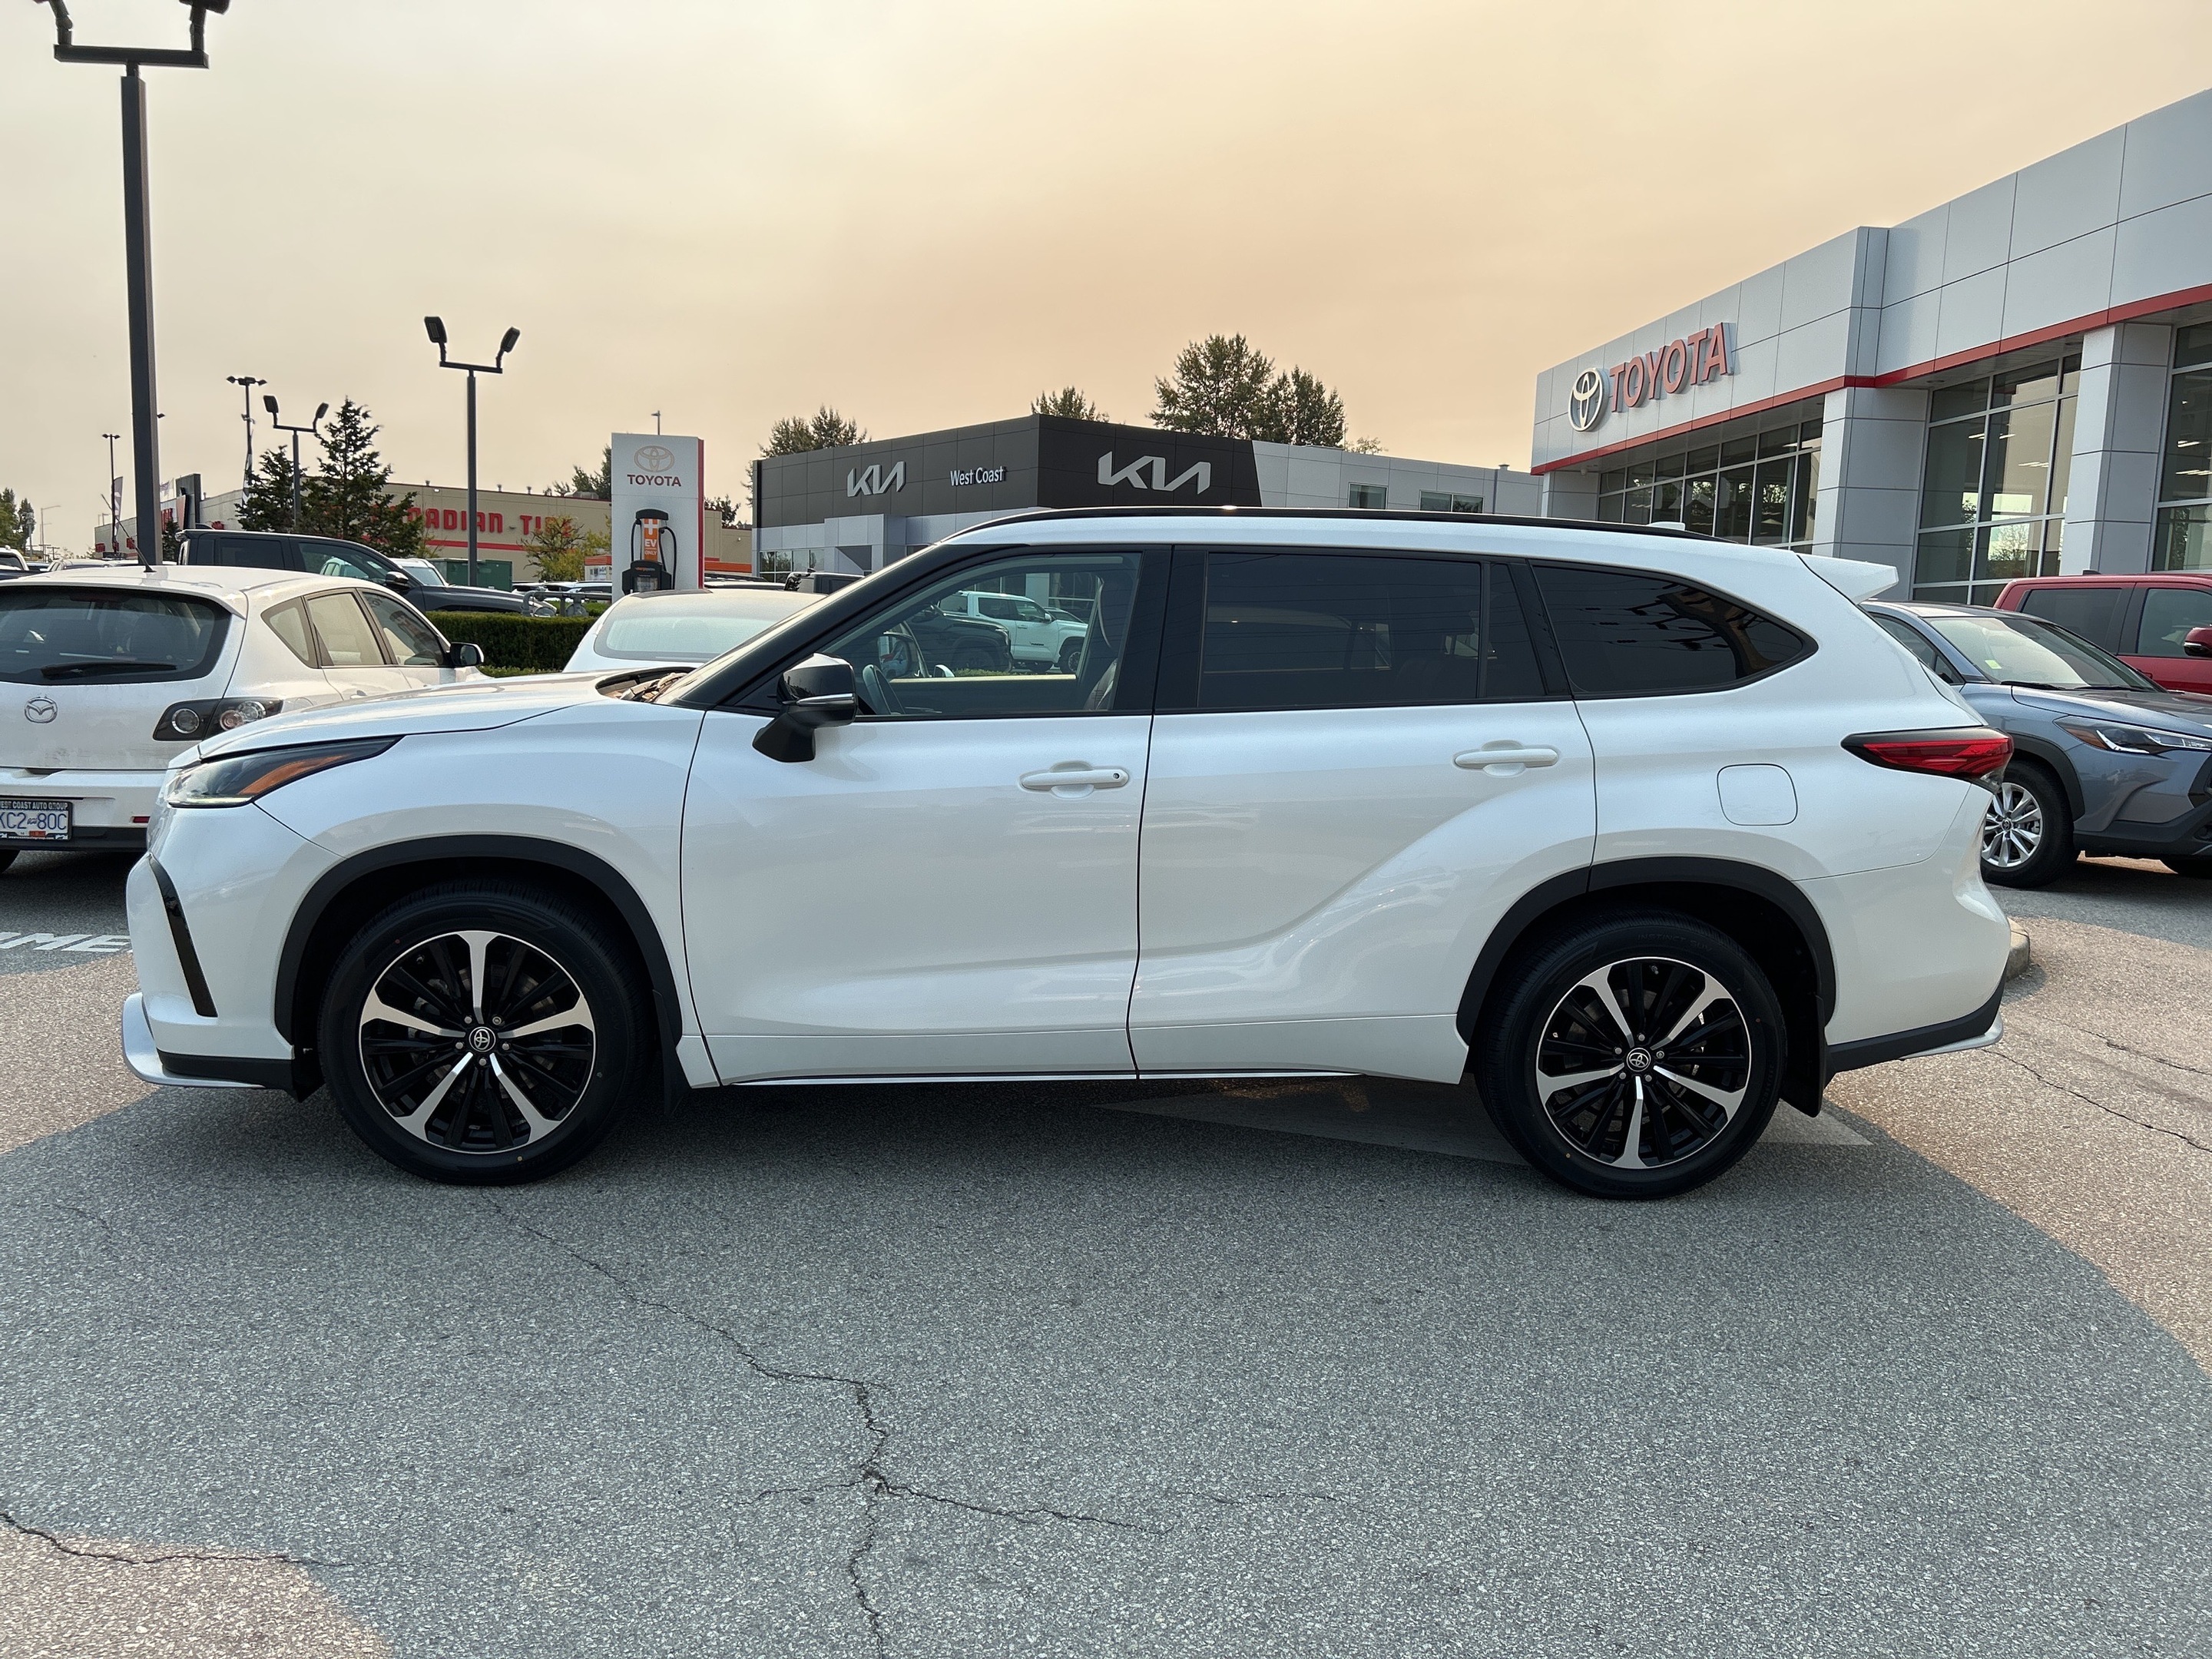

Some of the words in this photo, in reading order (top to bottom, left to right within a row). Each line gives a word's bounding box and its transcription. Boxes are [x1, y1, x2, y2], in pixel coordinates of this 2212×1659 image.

[1609, 323, 1731, 412] TOYOTA
[627, 474, 682, 487] TOYOTA
[847, 461, 906, 497] KIA
[950, 469, 974, 486] West
[975, 465, 1005, 484] Coast
[1098, 451, 1211, 495] KIA
[369, 504, 504, 533] NADIAN
[644, 538, 657, 548] EV
[0, 800, 12, 809] EST
[12, 801, 31, 810] COAST
[0, 932, 134, 953] ME
[1637, 933, 1687, 942] INSTINCT
[1690, 939, 1714, 952] SUV
